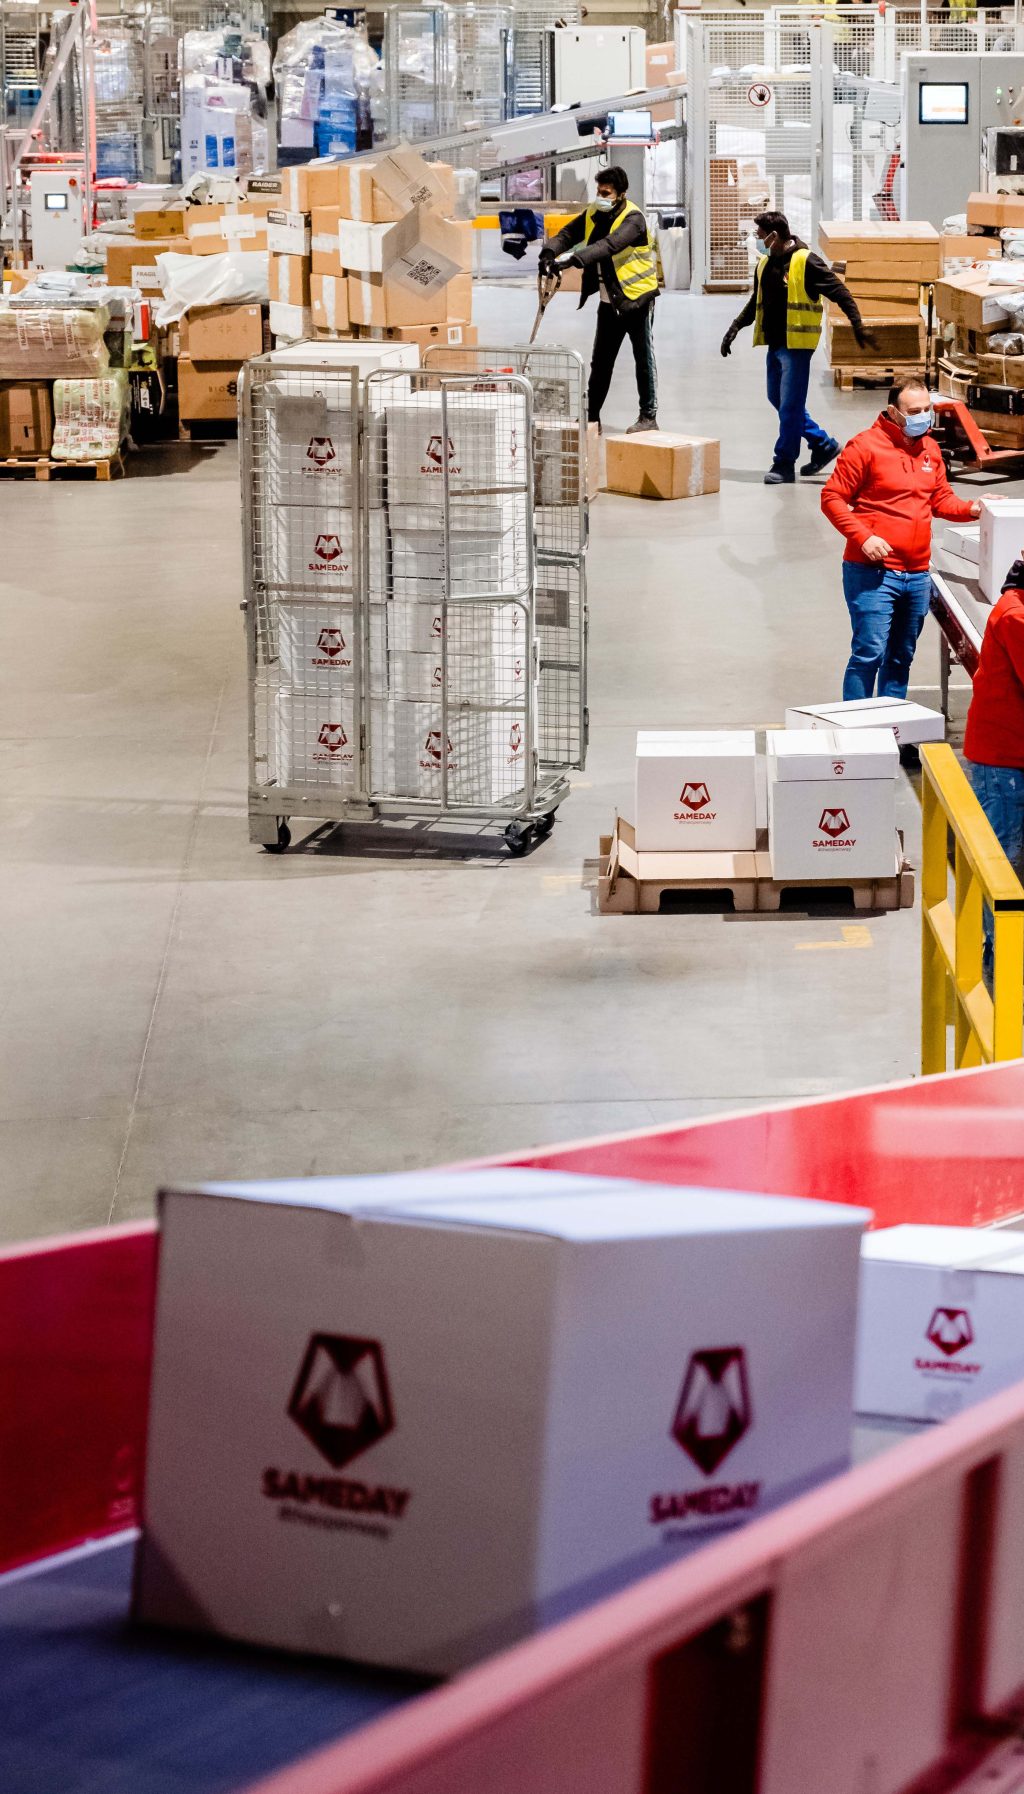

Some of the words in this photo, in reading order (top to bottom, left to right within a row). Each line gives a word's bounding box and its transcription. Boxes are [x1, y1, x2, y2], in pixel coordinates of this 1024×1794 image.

[420, 466, 462, 474] SAMAY
[308, 563, 349, 572] SAMEDAY
[312, 658, 352, 666] SAMEDAY
[673, 812, 717, 820] SAMEDAY
[812, 839, 857, 848] SAMEDAY
[262, 1467, 411, 1519] SAMEDAY
[649, 1482, 760, 1525] SAMEDAY
